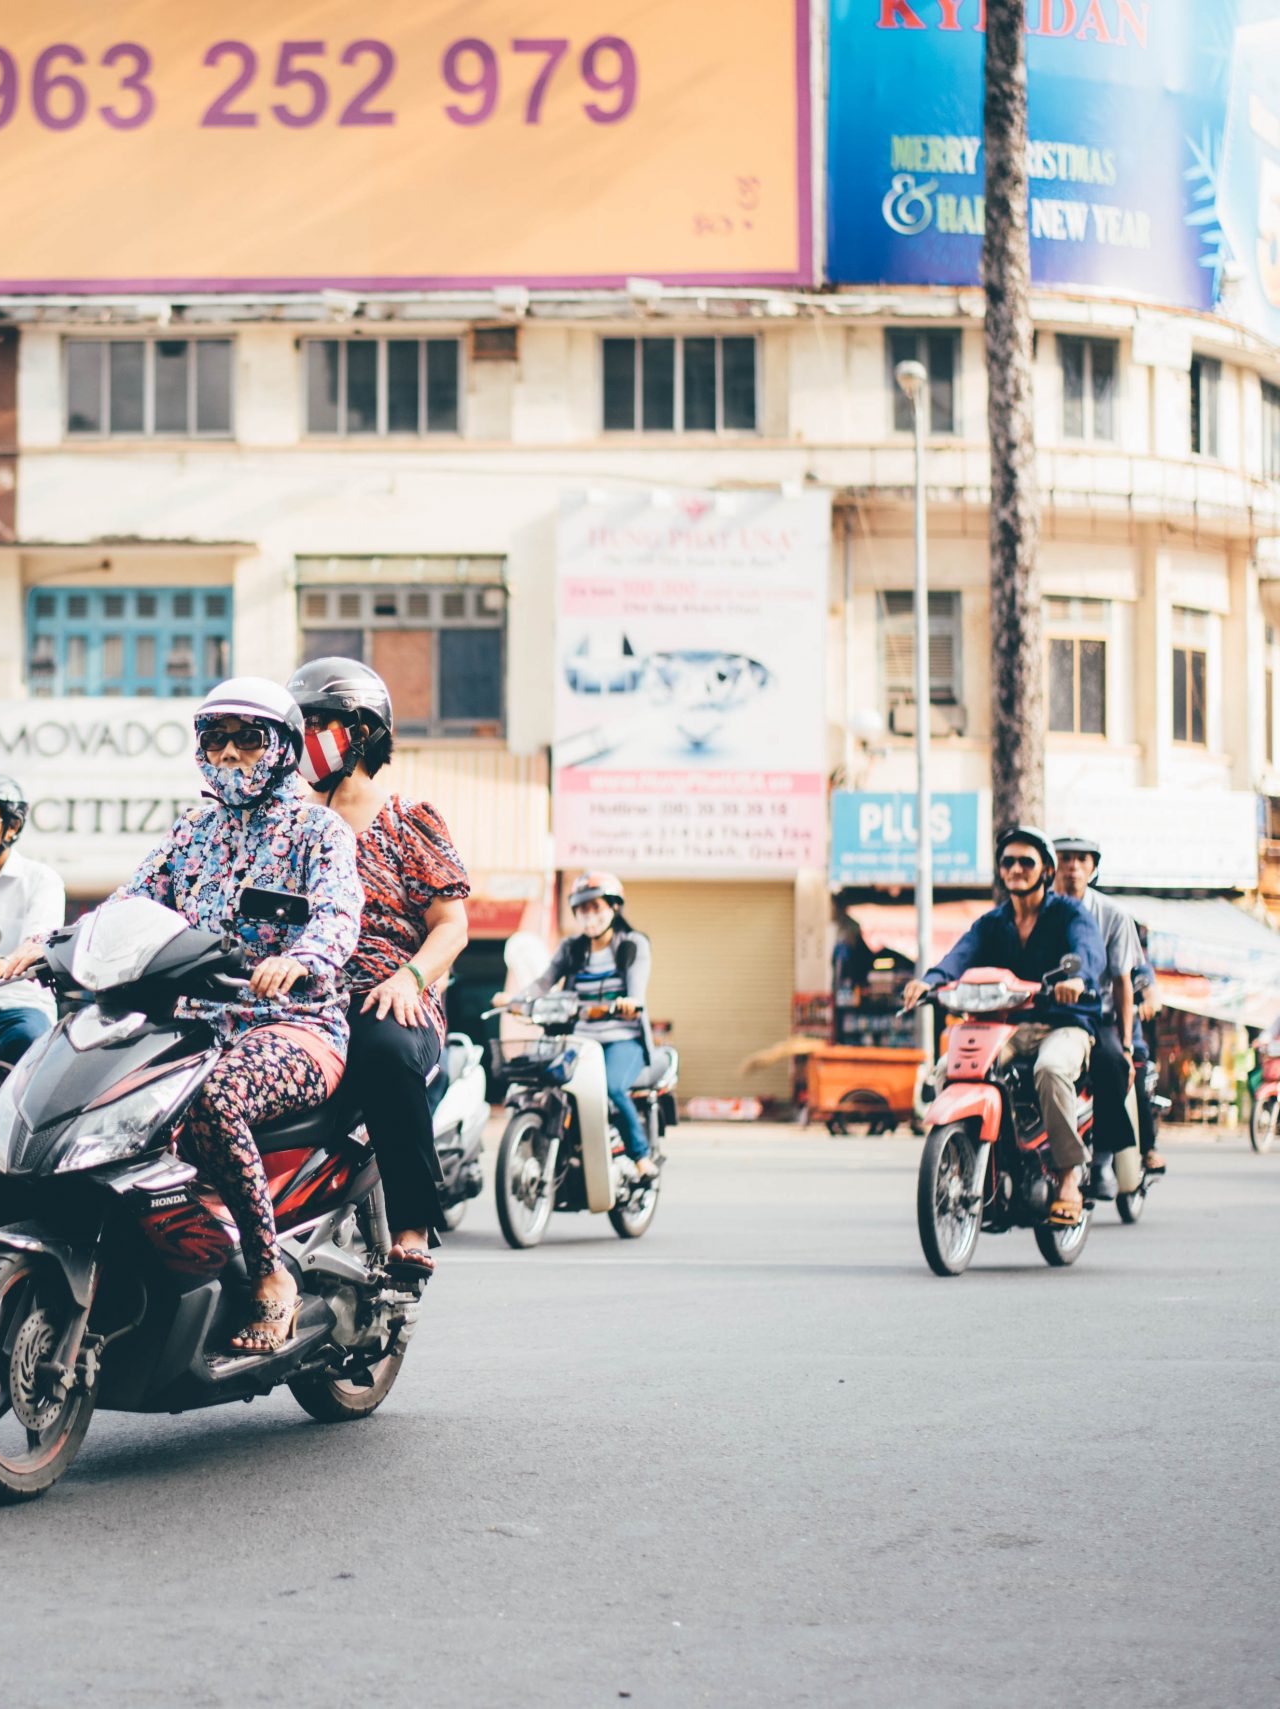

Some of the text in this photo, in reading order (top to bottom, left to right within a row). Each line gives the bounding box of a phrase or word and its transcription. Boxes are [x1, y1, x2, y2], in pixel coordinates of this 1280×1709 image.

[876, 0, 1149, 49] KYDAN
[200, 39, 397, 129] 252
[442, 35, 638, 127] 979
[890, 135, 981, 175] MERRY
[1031, 198, 1089, 242] NEW
[1090, 203, 1153, 249] YEAR
[30, 796, 212, 834] CITIZE
[859, 802, 952, 844] PLUS
[151, 1194, 188, 1208] HONDA
